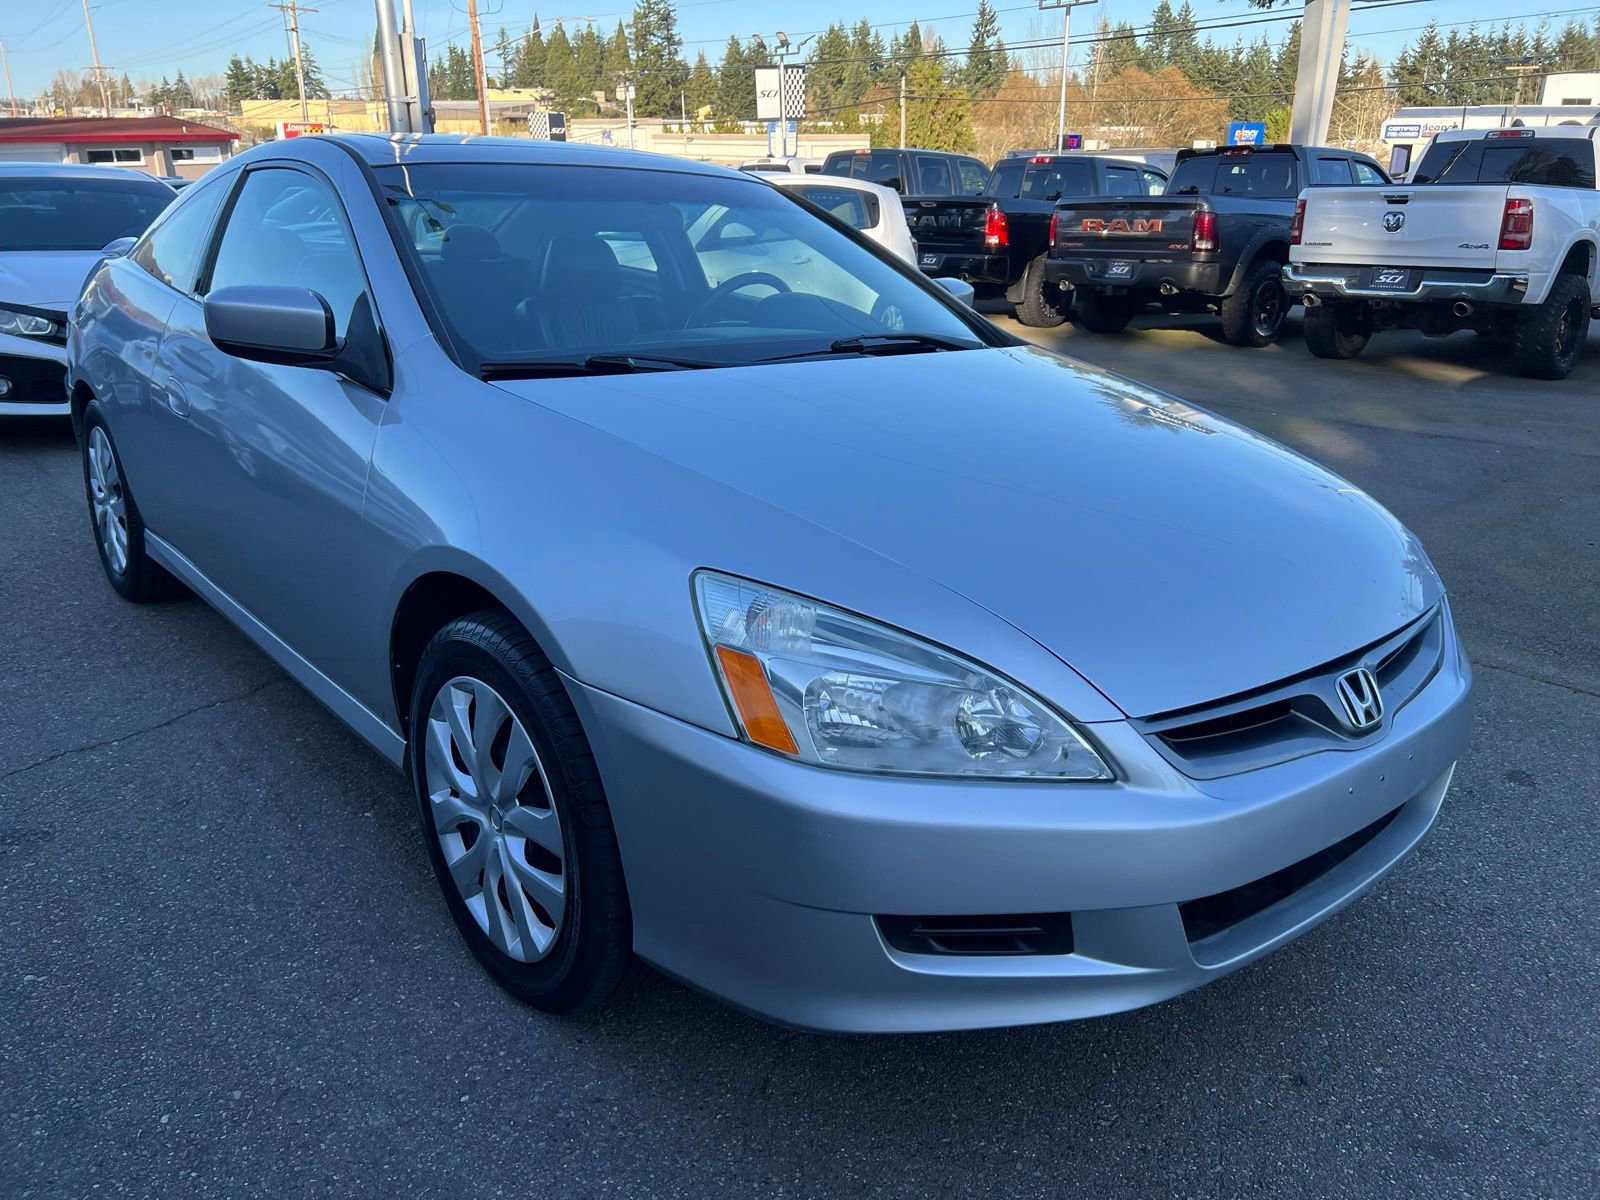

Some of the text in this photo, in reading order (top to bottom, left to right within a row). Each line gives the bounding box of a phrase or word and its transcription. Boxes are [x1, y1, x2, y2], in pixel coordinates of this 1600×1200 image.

[758, 90, 779, 98] SCI
[1081, 218, 1163, 233] RAM
[920, 256, 937, 265] SCI
[1109, 266, 1130, 274] SCI
[1375, 274, 1404, 283] SCI
